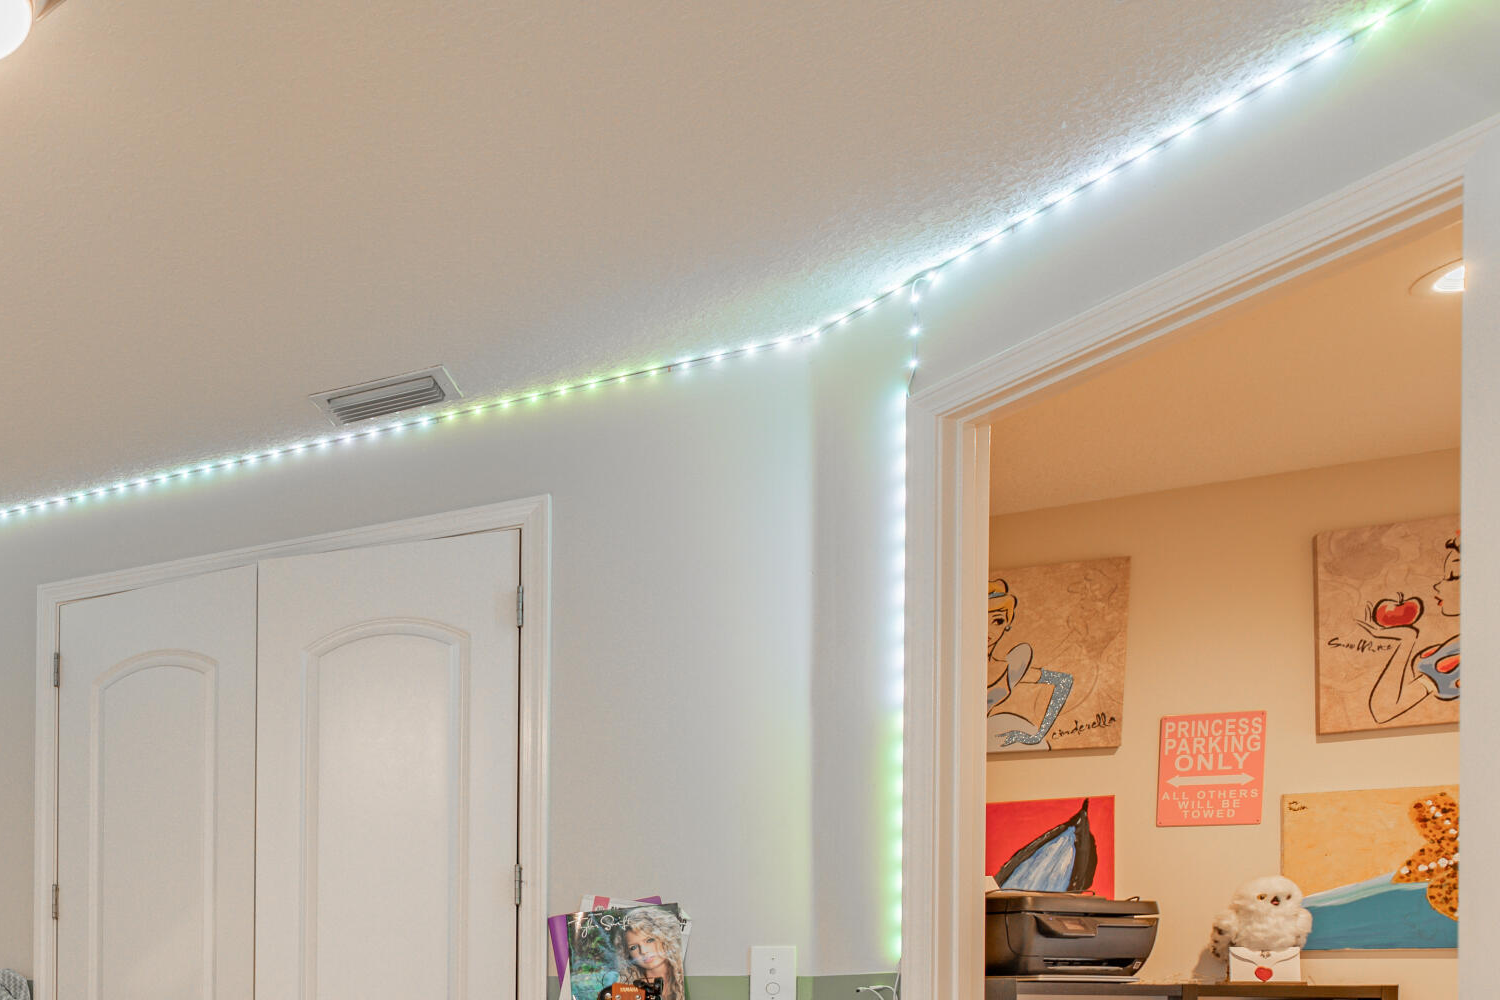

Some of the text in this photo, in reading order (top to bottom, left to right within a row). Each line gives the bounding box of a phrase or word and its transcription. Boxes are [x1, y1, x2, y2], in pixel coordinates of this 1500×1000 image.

[1164, 717, 1263, 738] PRINCESS
[1164, 735, 1261, 756] PARKING
[1174, 752, 1251, 772] ONLY
[1162, 788, 1259, 801] ALL OTHERS
[1178, 799, 1241, 809] WILL BE
[1182, 809, 1236, 819] TOWED
[567, 913, 630, 938] Taylor Swift
